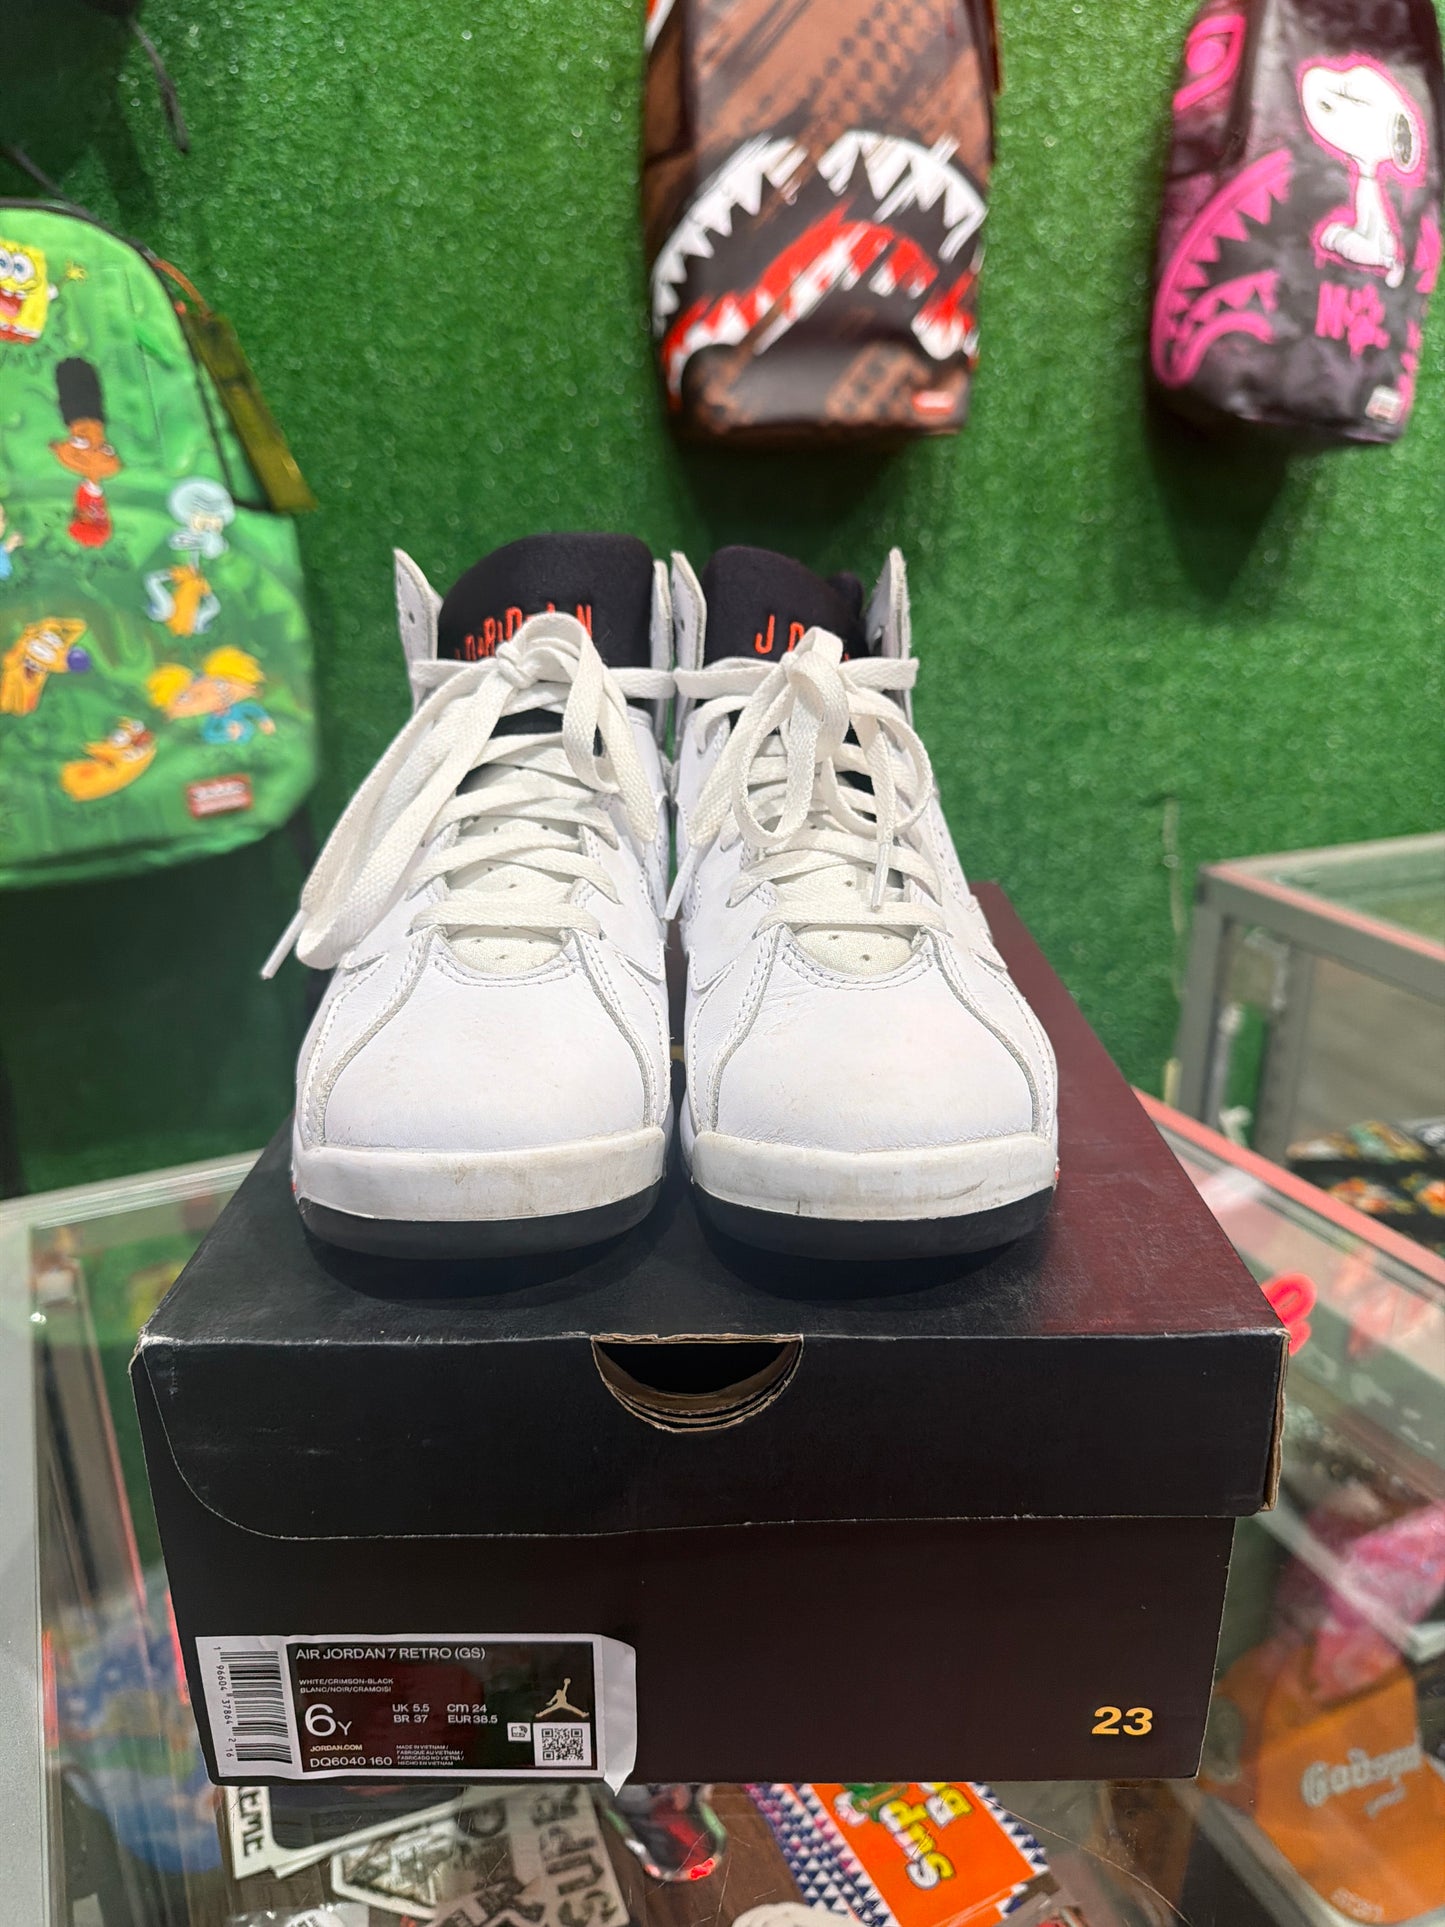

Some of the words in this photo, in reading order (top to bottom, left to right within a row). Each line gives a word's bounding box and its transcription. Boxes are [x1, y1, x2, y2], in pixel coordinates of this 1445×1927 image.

[296, 1648, 320, 1660] AIR
[323, 1648, 386, 1660] JORDAN
[387, 1648, 397, 1659] 7
[399, 1647, 452, 1659] RETRO
[454, 1647, 486, 1660] (GS)
[216, 1664, 228, 1691] 96604
[221, 1699, 233, 1725] 37864
[392, 1703, 410, 1713] UK
[412, 1703, 430, 1713] 5.5
[472, 1703, 488, 1713] 24
[393, 1714, 410, 1724] BR
[413, 1714, 429, 1724] 37
[447, 1714, 472, 1724] EUR
[473, 1714, 498, 1724] 38.5
[1091, 1705, 1153, 1736] 23
[225, 1748, 235, 1758] 16
[309, 1743, 363, 1753] JORDAN.COM
[310, 1756, 367, 1769] DQ6040
[368, 1756, 393, 1767] 160
